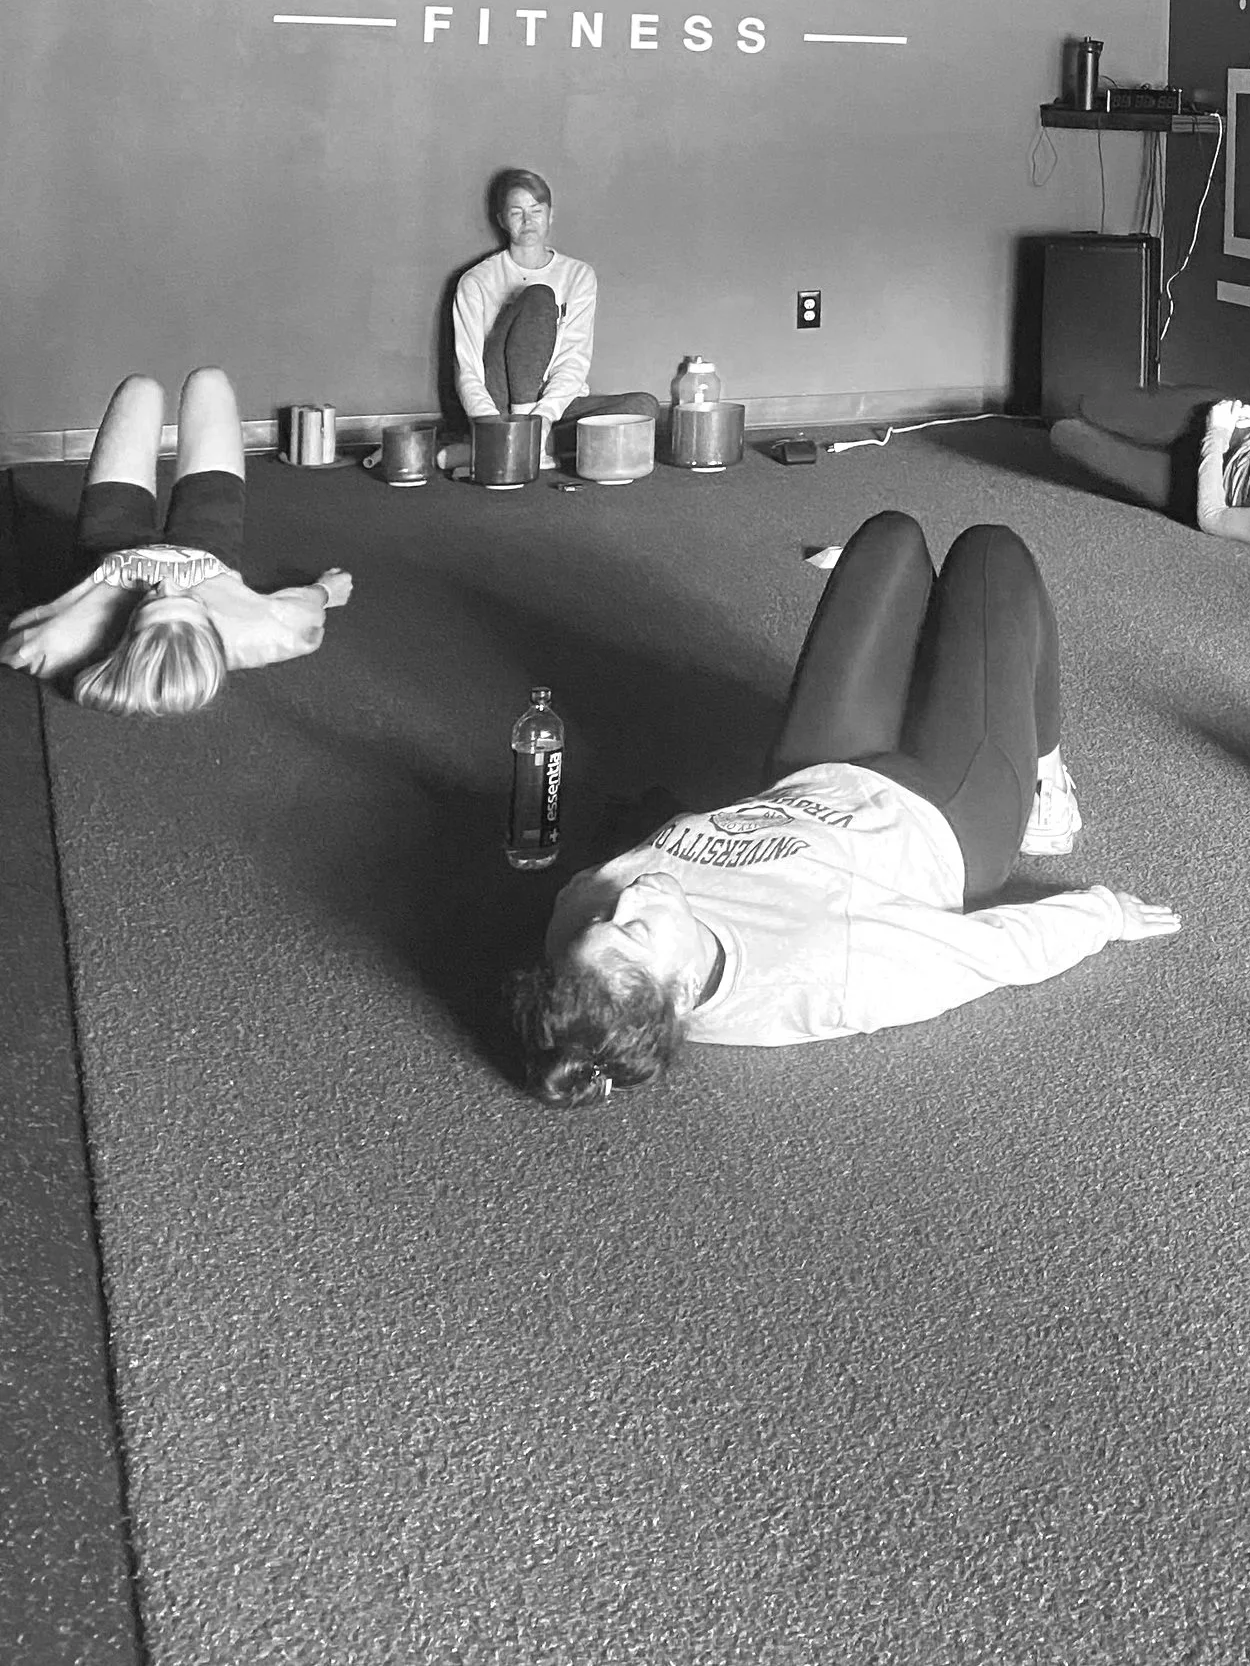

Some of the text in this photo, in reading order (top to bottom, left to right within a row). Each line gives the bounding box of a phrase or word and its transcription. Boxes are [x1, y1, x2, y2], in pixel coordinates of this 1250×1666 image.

[424, 5, 767, 54] FITNESS
[547, 752, 562, 822] essentia
[666, 827, 811, 868] UNIVERSITY
